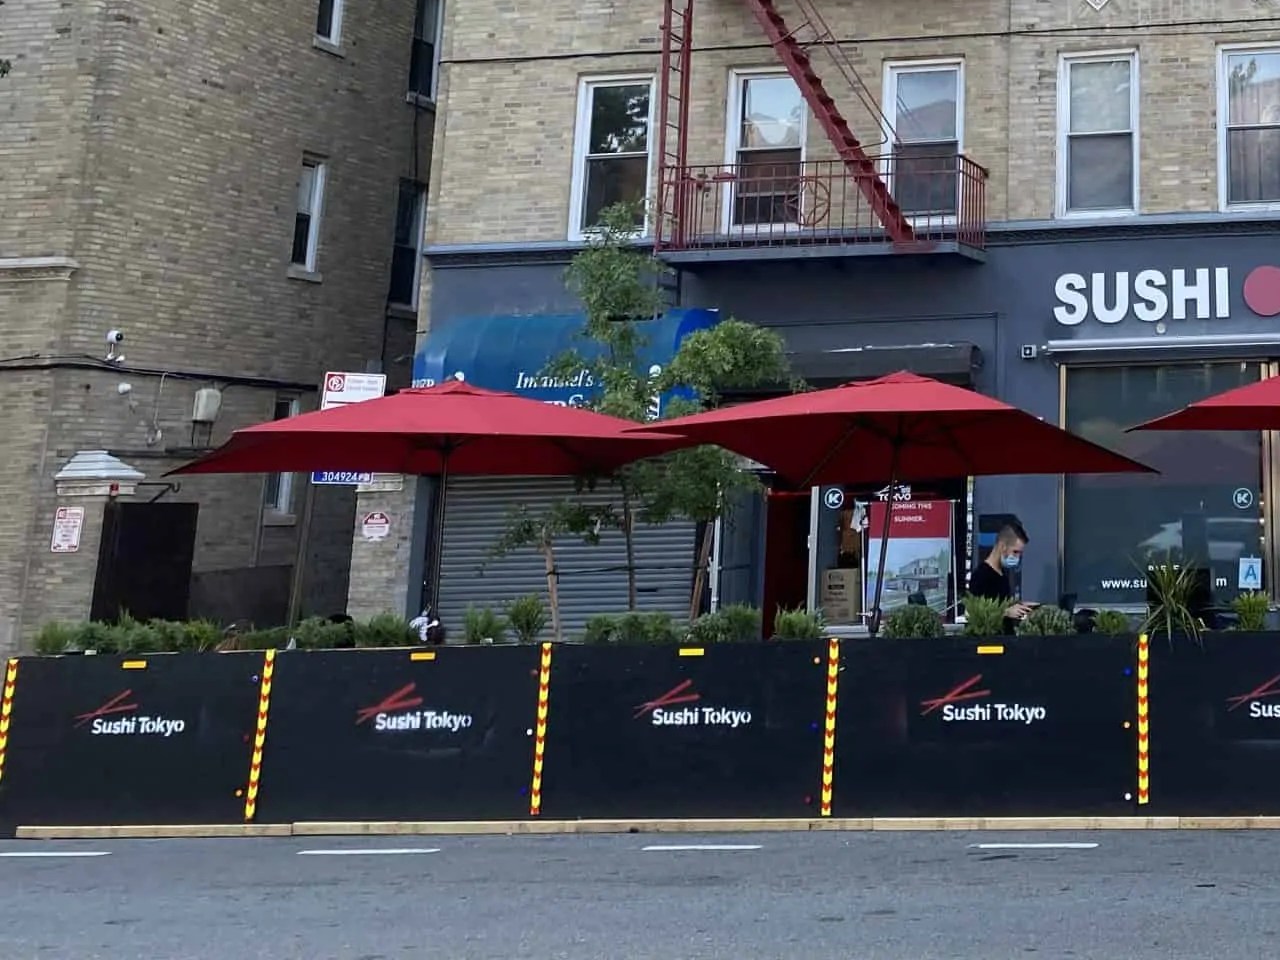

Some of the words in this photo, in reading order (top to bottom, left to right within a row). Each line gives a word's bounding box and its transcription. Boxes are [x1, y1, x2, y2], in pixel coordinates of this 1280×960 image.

[1053, 267, 1230, 326] SUSHI
[1245, 565, 1257, 581] A
[375, 712, 421, 730] Sushi
[423, 711, 472, 732] Tokyo
[652, 708, 698, 725] Sushi
[702, 707, 751, 727] Tokyo
[942, 704, 990, 722] Sushi
[994, 703, 1046, 724] Tokyo
[91, 717, 135, 735] Sushi
[138, 716, 185, 737] Tokyo
